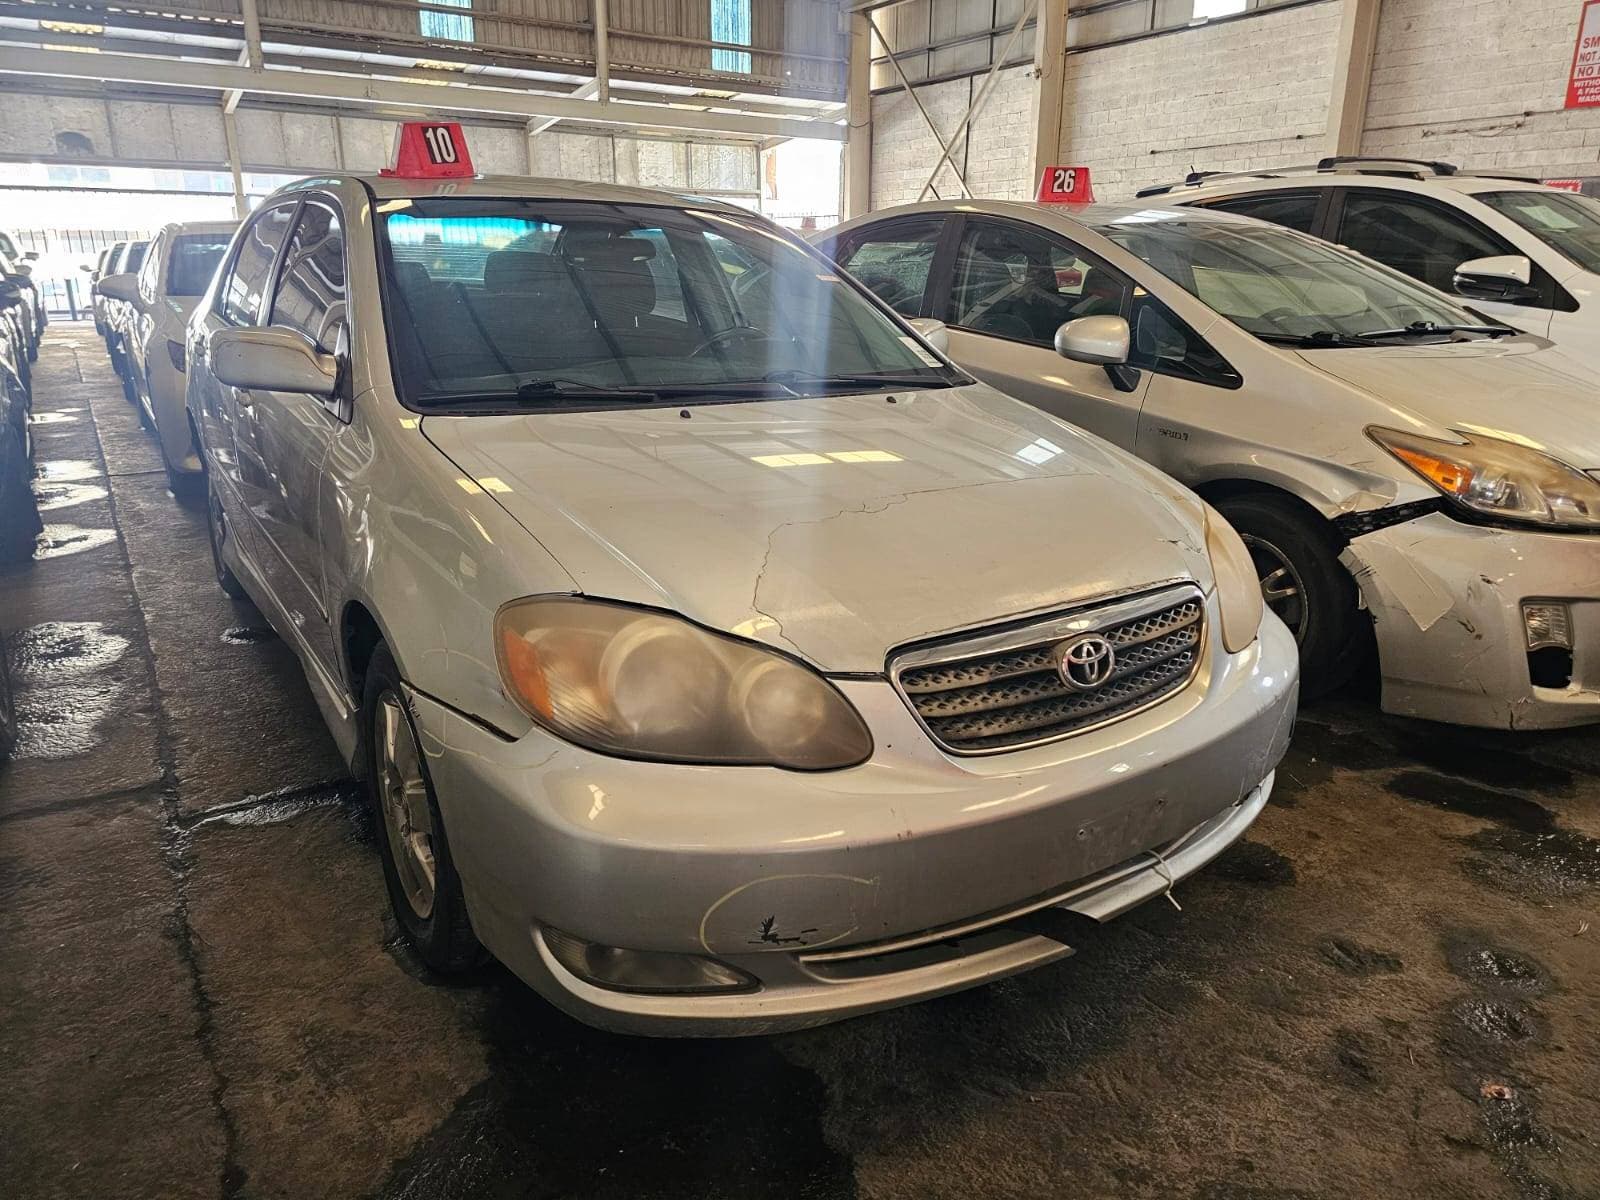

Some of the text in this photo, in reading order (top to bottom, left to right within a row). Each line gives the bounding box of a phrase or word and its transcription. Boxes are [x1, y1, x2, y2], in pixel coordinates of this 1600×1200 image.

[1579, 51, 1597, 63] NOT
[1577, 66, 1594, 77] NO
[425, 127, 456, 164] 10
[1053, 169, 1076, 193] 26
